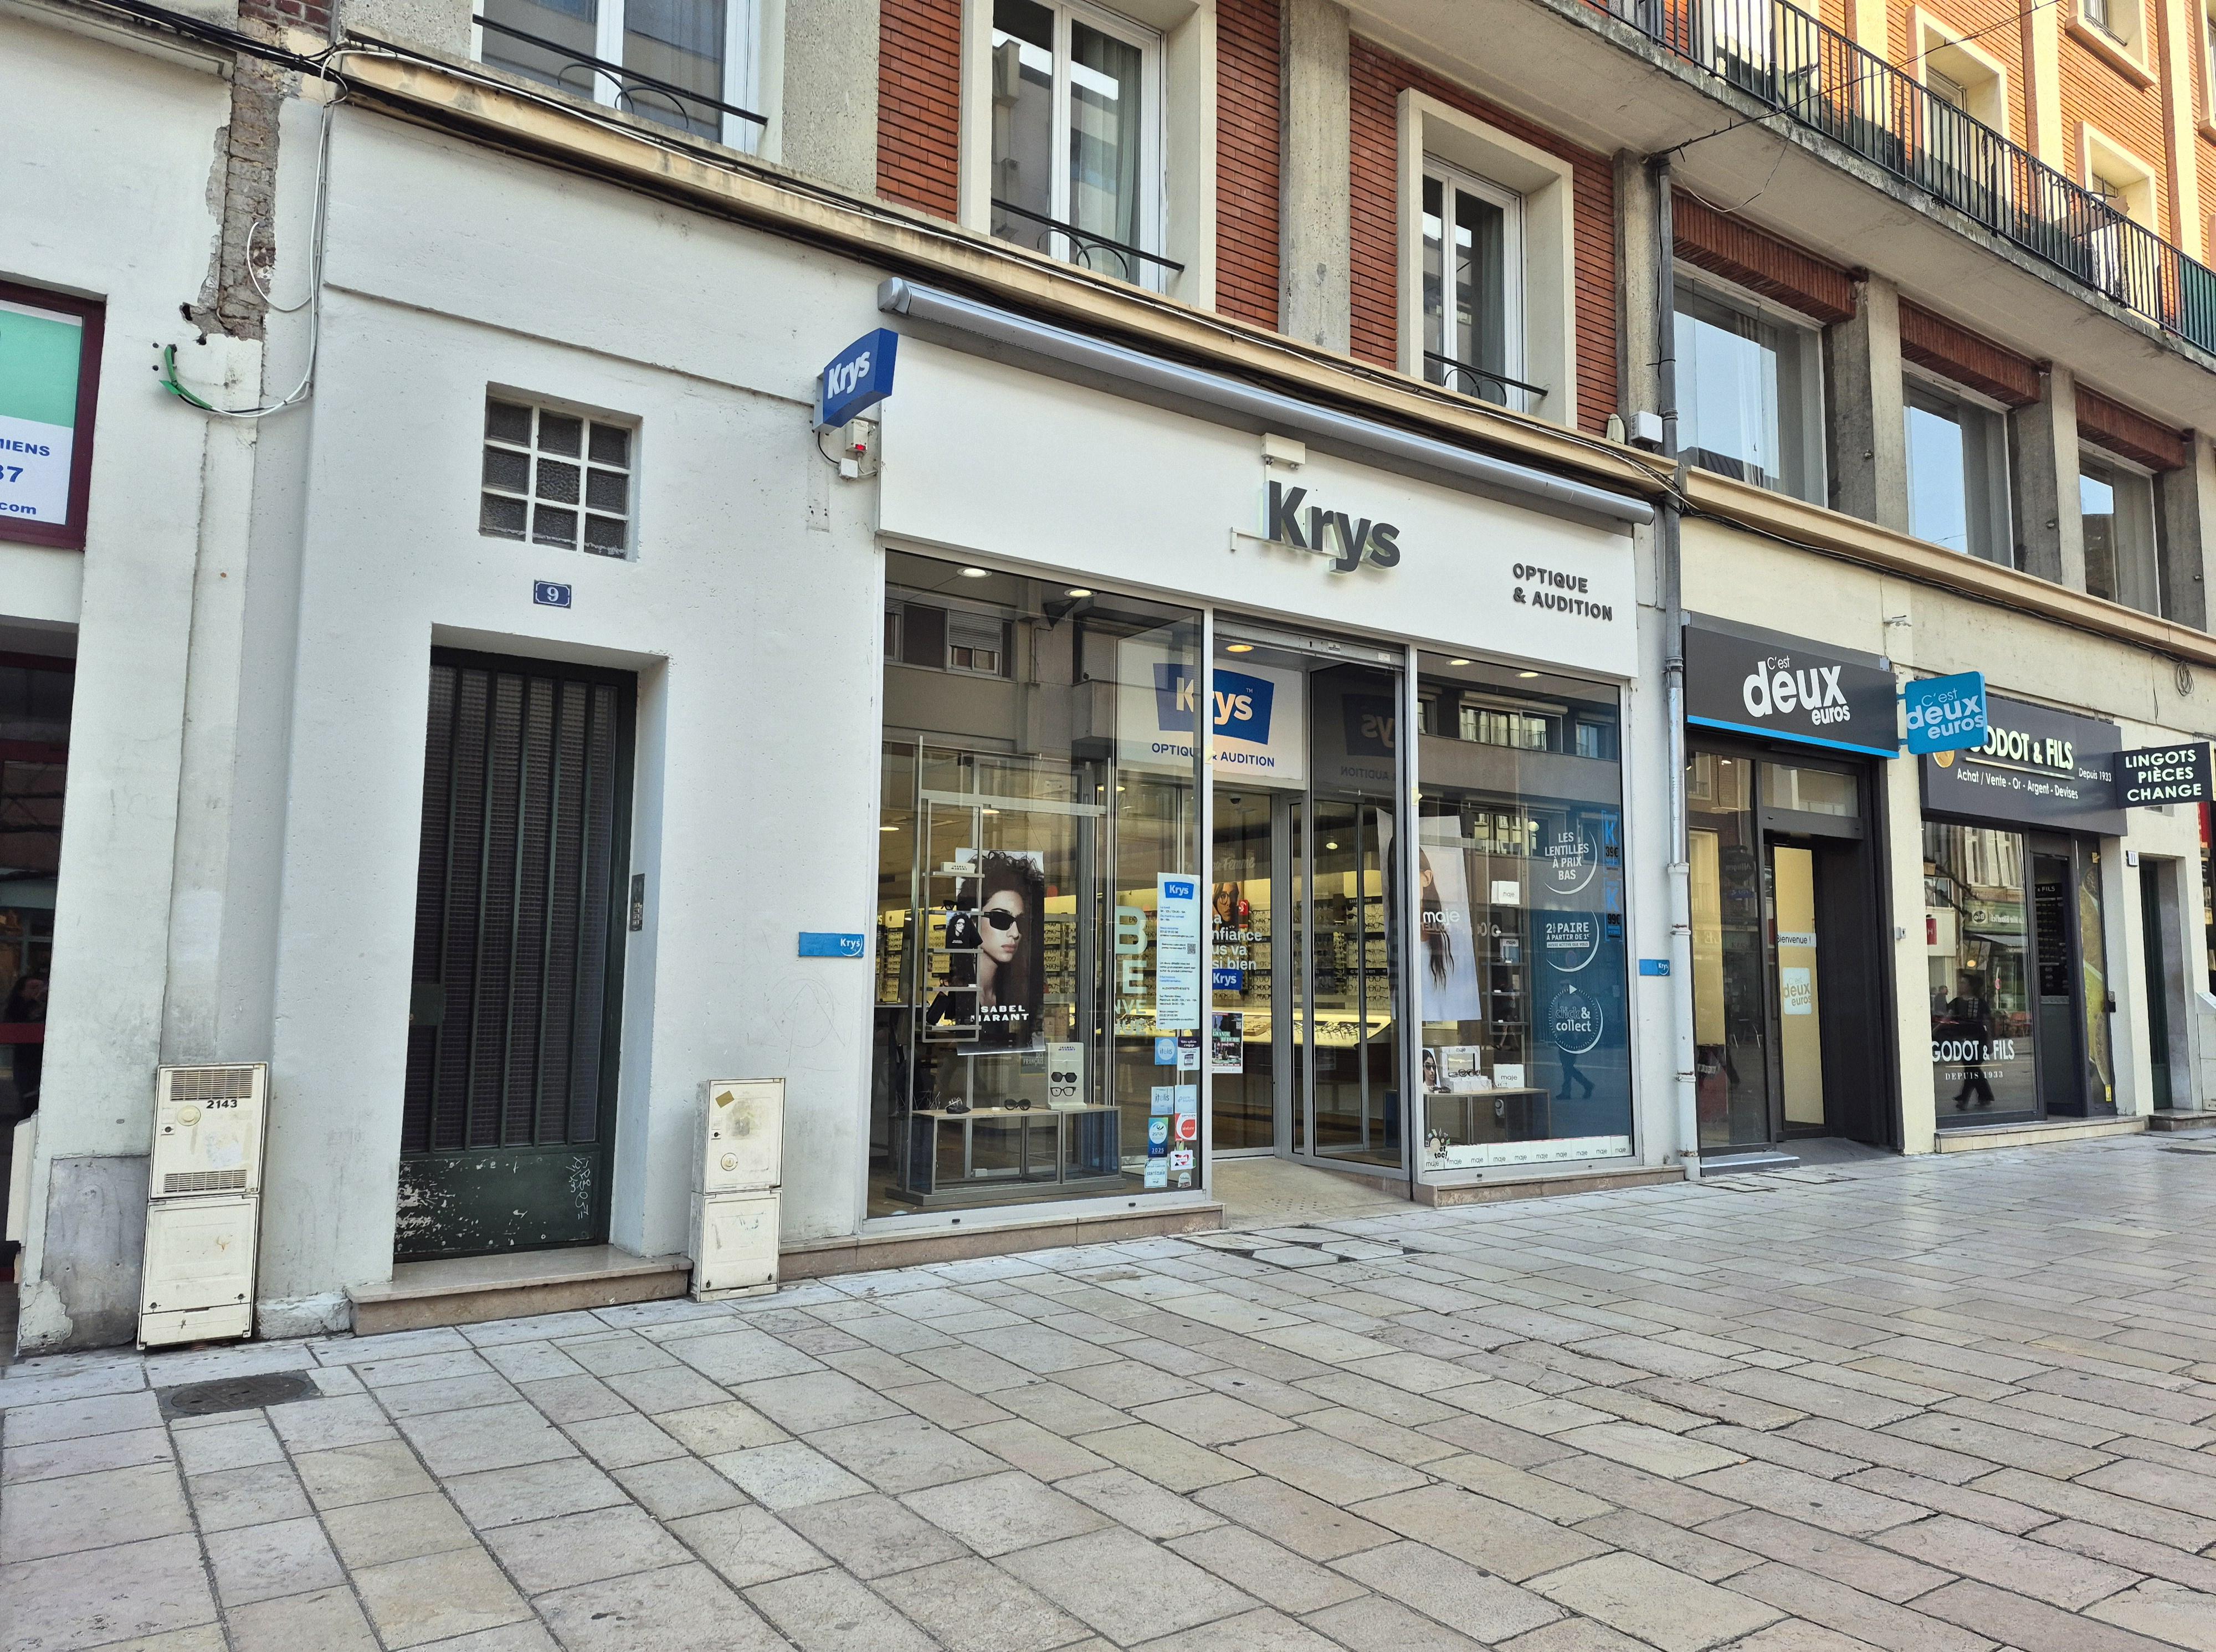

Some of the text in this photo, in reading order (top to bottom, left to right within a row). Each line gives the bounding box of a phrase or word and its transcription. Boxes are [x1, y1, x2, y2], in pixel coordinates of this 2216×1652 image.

[828, 351, 870, 399] Krys
[1263, 480, 1400, 573] Krys
[1512, 563, 1588, 593] OPTIQUE
[546, 586, 559, 602] 9
[1513, 587, 1613, 621] & AUDITION
[1767, 655, 1791, 670] C'est
[1743, 660, 1848, 717] deux
[1176, 676, 1253, 725] Kys
[1921, 688, 1958, 707] C'est
[1812, 705, 1851, 726] euros
[1907, 695, 1982, 730] deux
[1927, 715, 1984, 740] euros
[1970, 726, 2074, 771] ODOT & FILS
[1220, 751, 1274, 767] AUDITION
[2125, 749, 2196, 768] LINGOTS
[2079, 767, 2112, 782] Depuis 1933
[2138, 766, 2194, 784] PIÈCES
[1957, 768, 1979, 783] Achat
[1986, 772, 2007, 788] Vente
[2013, 777, 2021, 790] Or
[2027, 781, 2049, 796] Argent
[2055, 784, 2079, 799] Devises
[2127, 783, 2202, 802] CHANGE
[1558, 832, 1574, 843] LES
[1545, 843, 1589, 856] LENTILLES
[1605, 846, 1618, 858] 39€
[1552, 856, 1582, 868] À PRIX
[1558, 869, 1576, 880] BAS
[1169, 885, 1189, 896] Krys
[1423, 909, 1460, 926] maje
[1557, 922, 1589, 933] PAIRE
[840, 938, 860, 950] Krys
[1777, 934, 1808, 944] Bienvenue
[1231, 945, 1248, 956] va
[1227, 957, 1256, 971] bien
[1213, 973, 1237, 986] Krys
[1783, 983, 1811, 998] deux
[981, 1005, 1025, 1013] SABEL
[1791, 996, 1811, 1007] euros
[1556, 1006, 1591, 1019] click &
[1556, 1019, 1592, 1032] collect
[1932, 1039, 2015, 1063] GODOT & FILS
[1023, 1058, 1044, 1066] FRANÇAIS
[1945, 1071, 1979, 1080] DEPUIS
[206, 1099, 238, 1109] 2143
